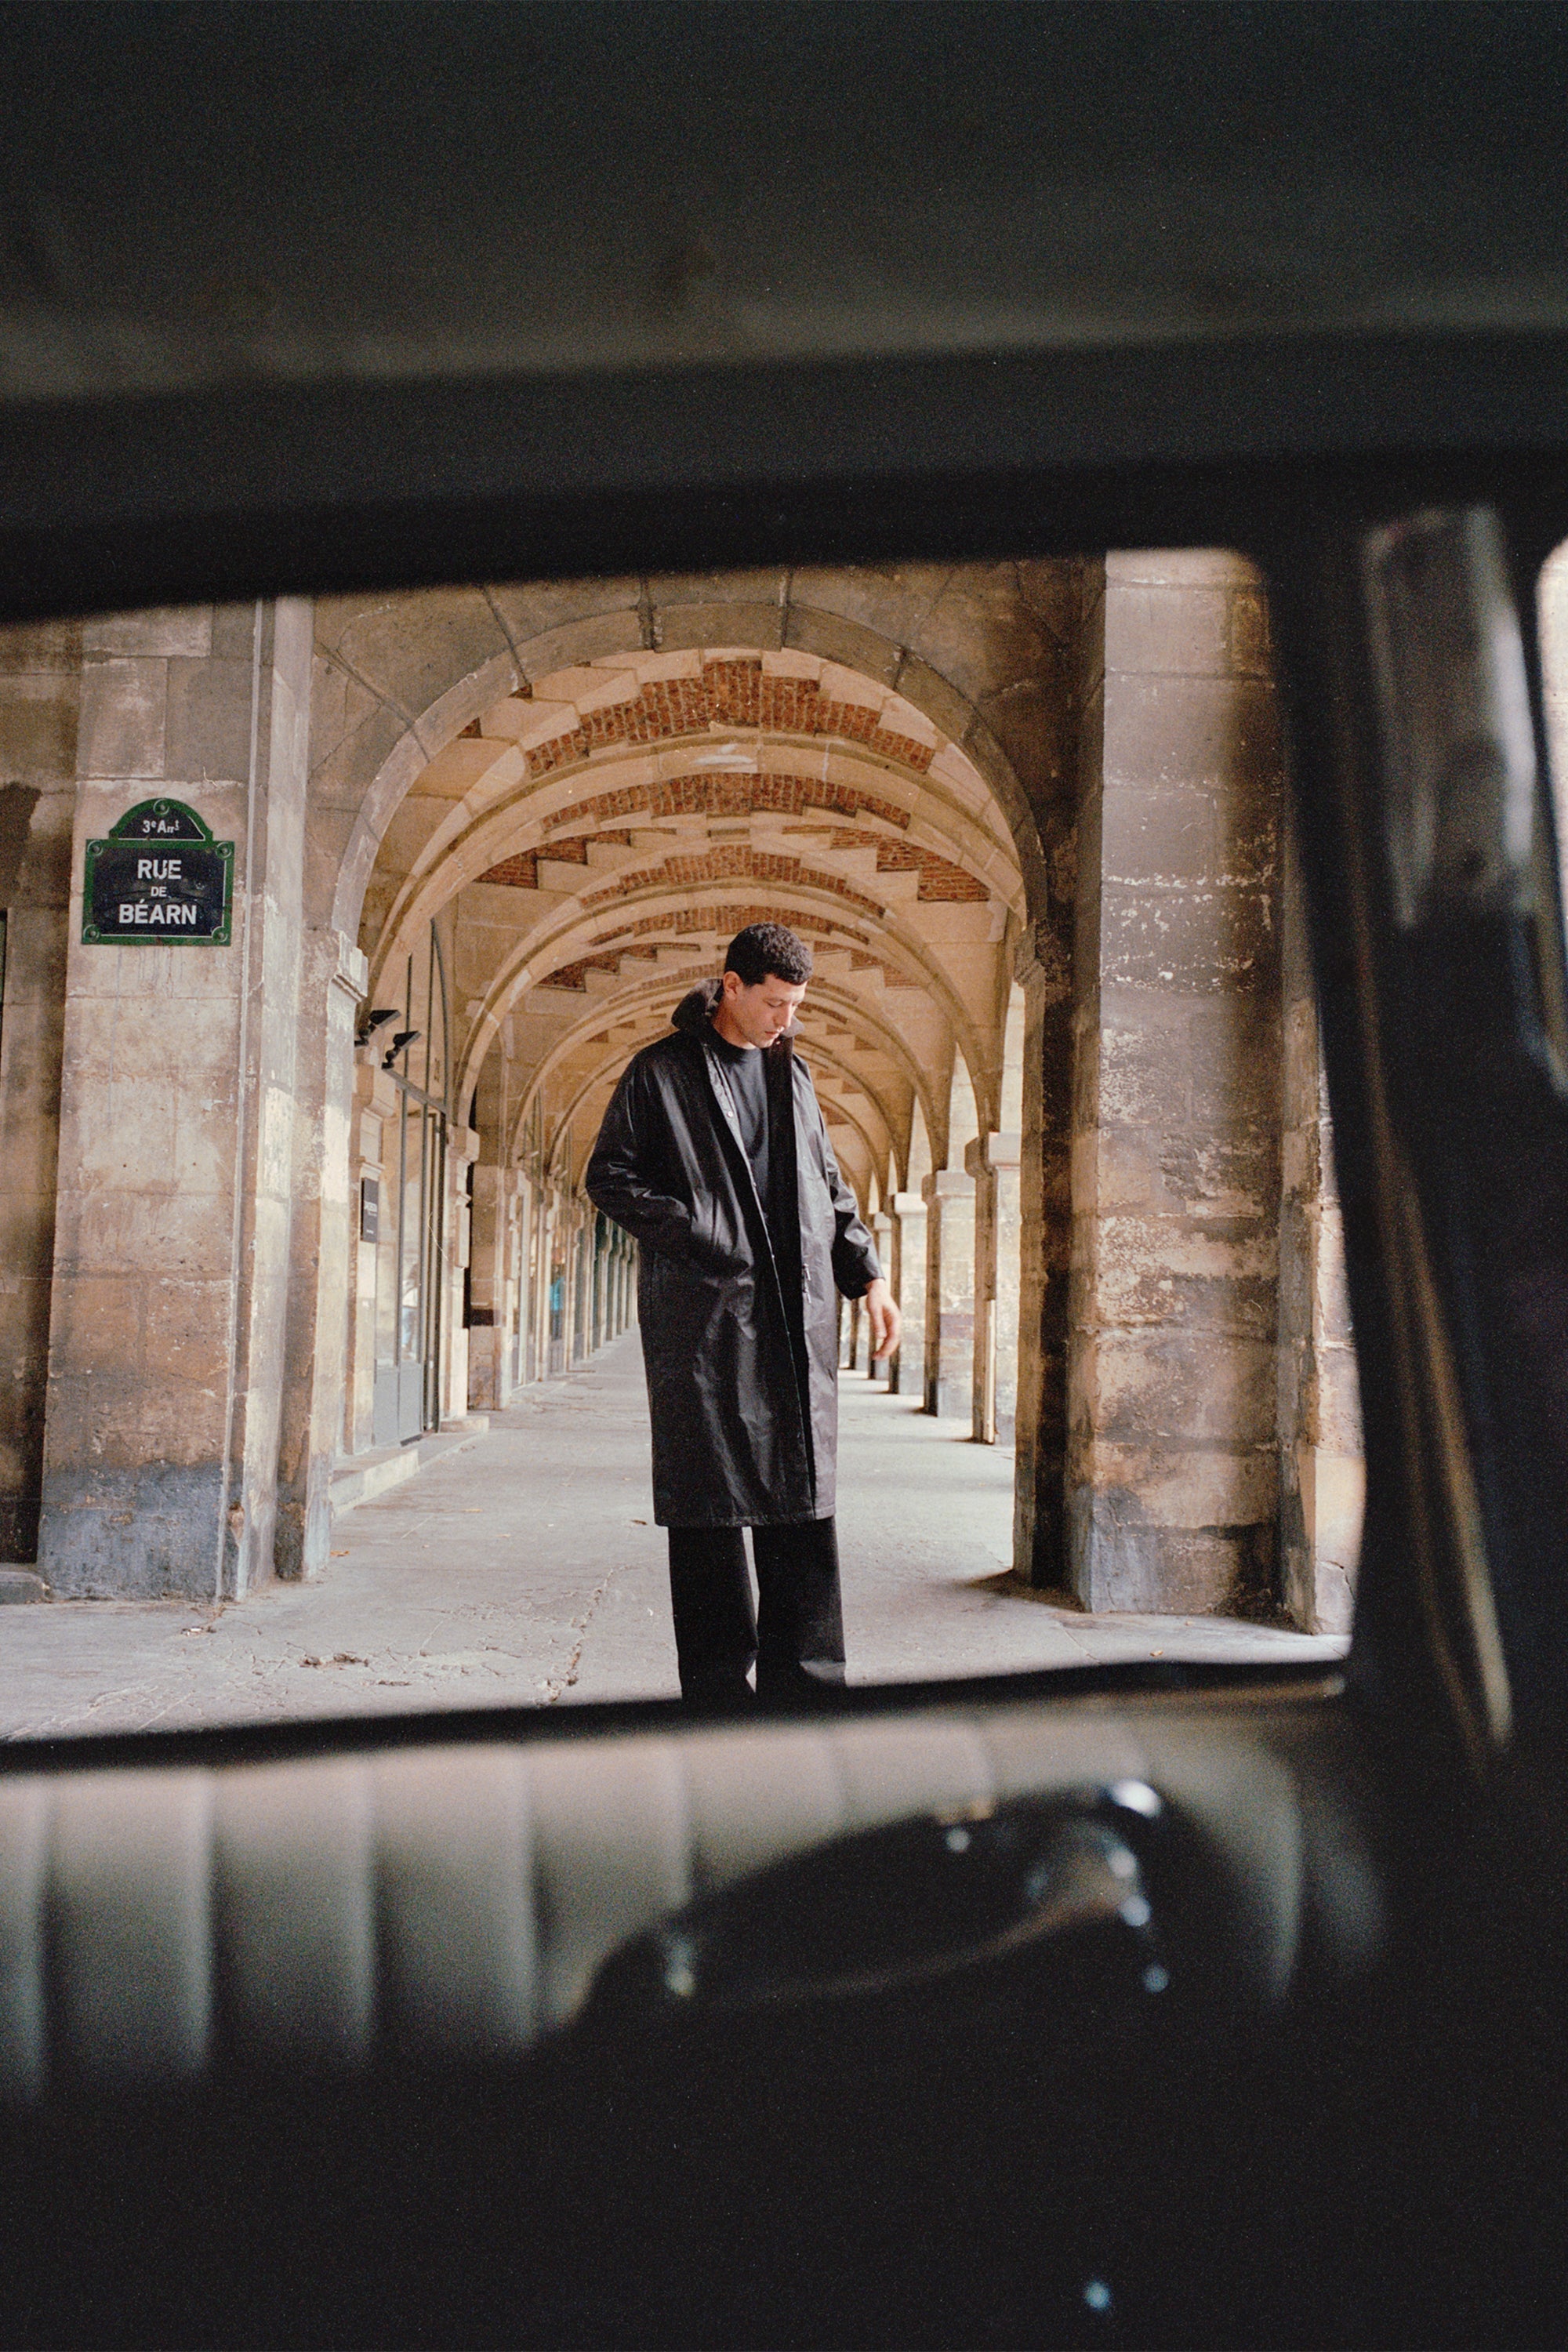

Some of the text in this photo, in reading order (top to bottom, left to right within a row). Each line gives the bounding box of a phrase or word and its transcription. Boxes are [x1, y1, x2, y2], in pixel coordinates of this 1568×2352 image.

[137, 859, 182, 880] RUE
[150, 887, 167, 897] DE
[118, 898, 197, 925] BÉARN
